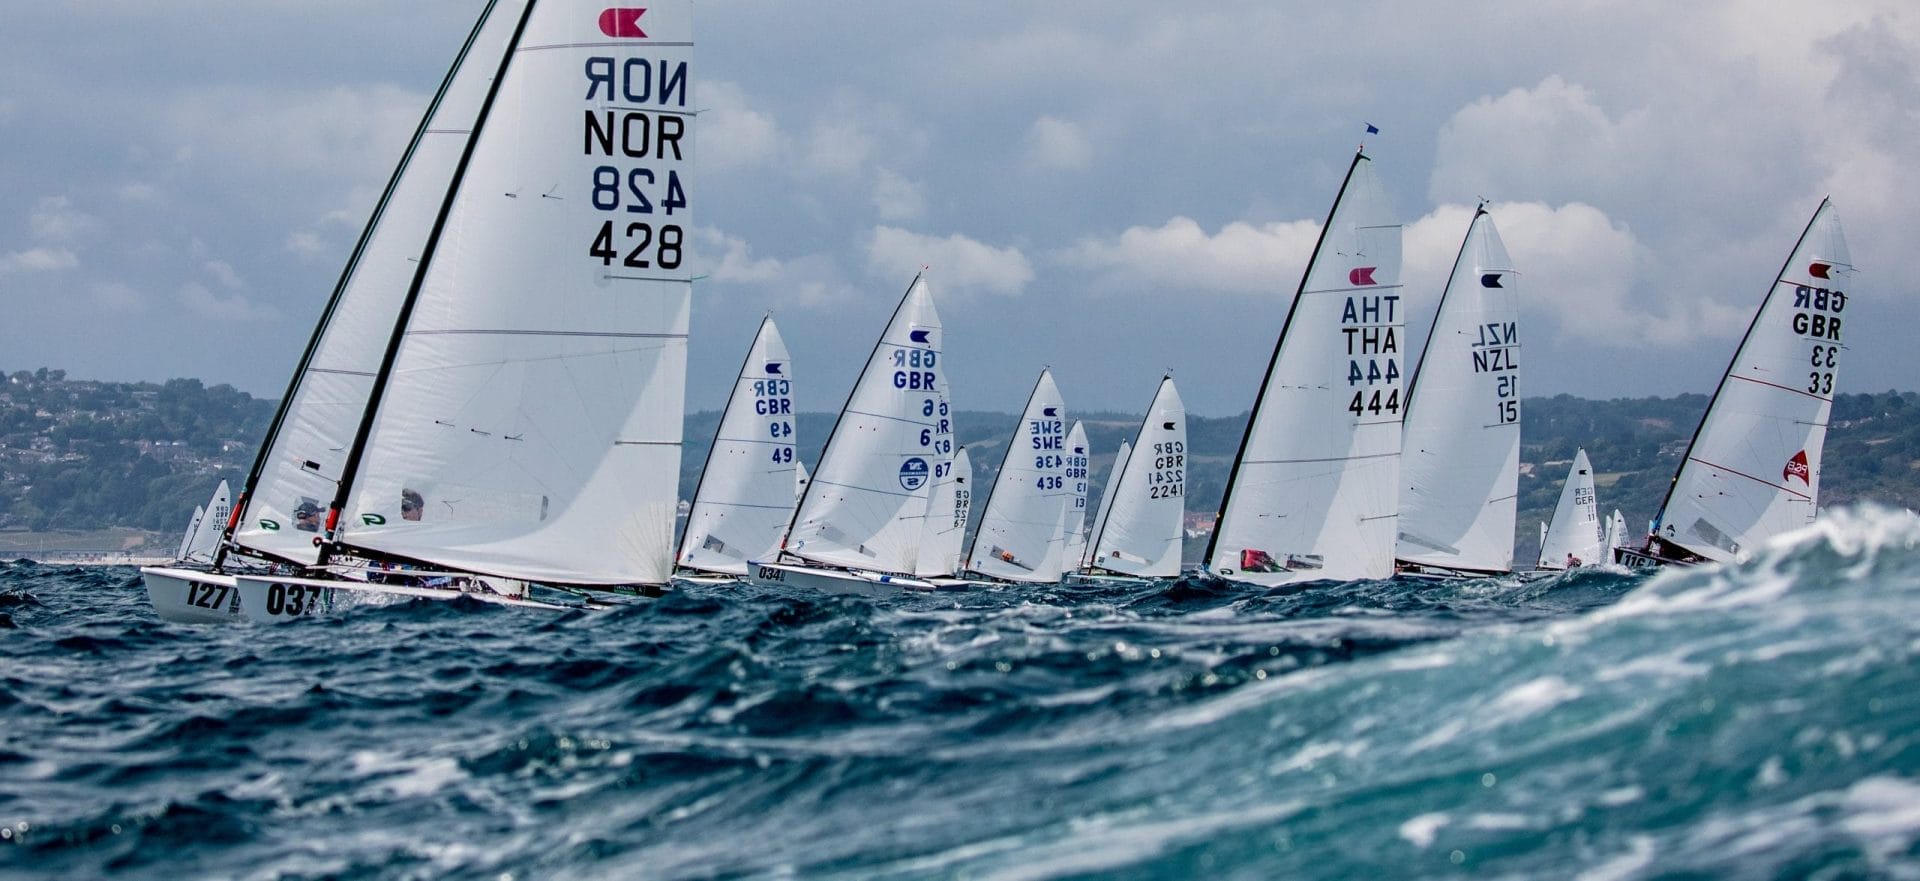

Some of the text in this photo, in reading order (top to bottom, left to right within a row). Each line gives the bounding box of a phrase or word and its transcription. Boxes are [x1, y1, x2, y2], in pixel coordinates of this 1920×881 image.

[584, 110, 684, 160] NOR
[590, 220, 683, 269] 428
[1793, 313, 1841, 340] GBR
[1342, 327, 1397, 355] THA
[1473, 348, 1517, 373] NZL
[893, 371, 936, 390] GBR
[1808, 372, 1833, 394] 33
[756, 399, 790, 415] GBR
[1349, 388, 1399, 416] 444
[1498, 401, 1517, 423] 15
[920, 428, 931, 447] 6
[1033, 436, 1063, 450] SWE
[772, 447, 792, 464] 49
[1155, 455, 1183, 469] GBR
[935, 461, 951, 478] 87
[1066, 468, 1087, 479] GBR
[1037, 476, 1062, 490] 436
[1150, 483, 1183, 499] 2241
[1075, 498, 1085, 508] 13
[1575, 496, 1594, 505] GER
[759, 566, 780, 580] 034
[187, 580, 229, 610] 127
[266, 583, 321, 616] 037
